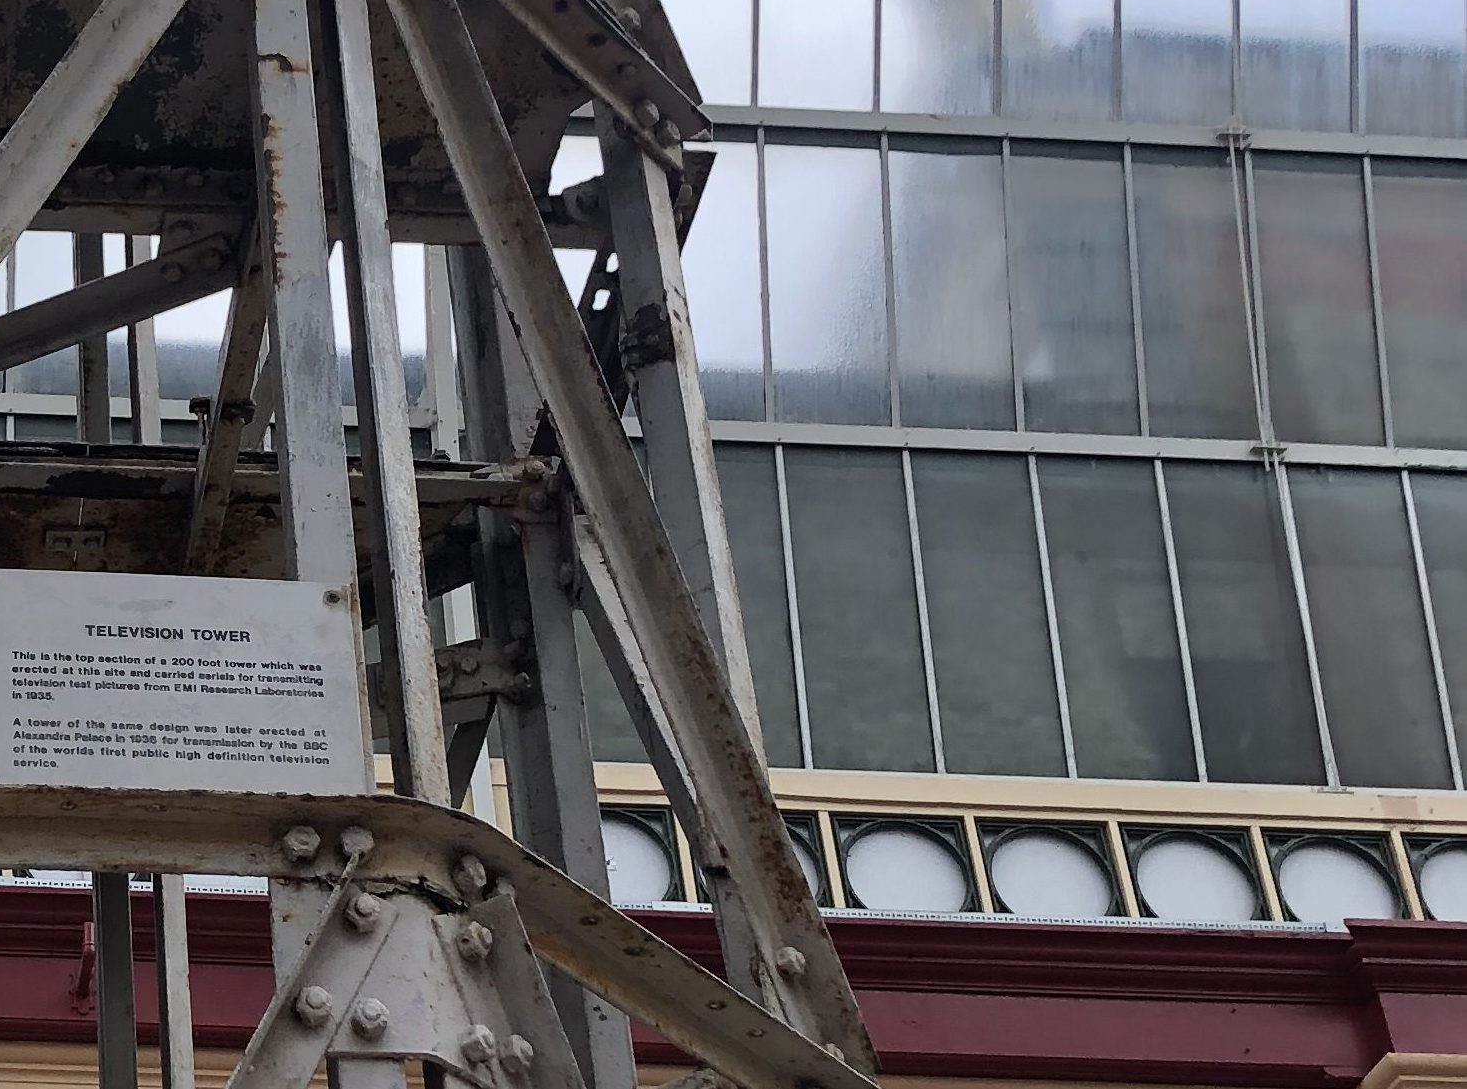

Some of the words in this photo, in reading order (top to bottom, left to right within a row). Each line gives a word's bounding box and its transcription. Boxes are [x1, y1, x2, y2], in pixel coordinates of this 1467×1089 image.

[85, 624, 184, 640] TELEVISION
[191, 629, 251, 642] TOWER
[12, 651, 36, 660] This
[40, 652, 50, 661] is
[54, 653, 72, 662] the
[76, 654, 94, 664] top
[98, 655, 141, 664] section
[145, 657, 155, 665] of
[171, 658, 194, 666] 200
[198, 658, 221, 667] foot
[224, 660, 257, 669] tower
[261, 661, 294, 670] which
[12, 666, 57, 674] erected
[62, 667, 74, 675] at
[78, 667, 100, 676] this
[104, 668, 126, 676] site
[130, 669, 151, 678] and
[155, 671, 194, 680] carried
[238, 673, 254, 682] for
[258, 674, 324, 686] transmitting
[12, 678, 66, 688] television
[69, 680, 91, 688] test
[95, 681, 140, 690] pictures
[144, 683, 170, 692] from
[174, 684, 197, 693] EMI
[201, 686, 252, 695] Research
[255, 687, 324, 698] Laboratories
[12, 691, 22, 699] in
[25, 691, 54, 701] 1935.
[13, 718, 21, 726] A
[28, 718, 61, 727] tower
[67, 720, 80, 728] of
[86, 720, 105, 729] the
[111, 722, 143, 730] same
[150, 722, 189, 732] design
[194, 725, 218, 733] was
[226, 726, 252, 734] later
[259, 728, 305, 737] erected
[314, 729, 326, 737] at
[13, 731, 71, 741] Alexandra
[75, 733, 112, 742] Palace
[116, 734, 125, 743] in
[162, 736, 179, 744] for
[183, 737, 254, 748] transmission
[259, 740, 273, 750] by
[279, 741, 297, 749] the
[304, 742, 328, 750] BBC
[13, 745, 25, 753] of
[29, 745, 47, 754] the
[53, 746, 94, 755] worlds
[100, 747, 126, 757] first
[132, 749, 169, 758] public
[176, 751, 201, 760] high
[207, 752, 264, 762] definition
[270, 754, 330, 765] television
[13, 759, 59, 768] service.
